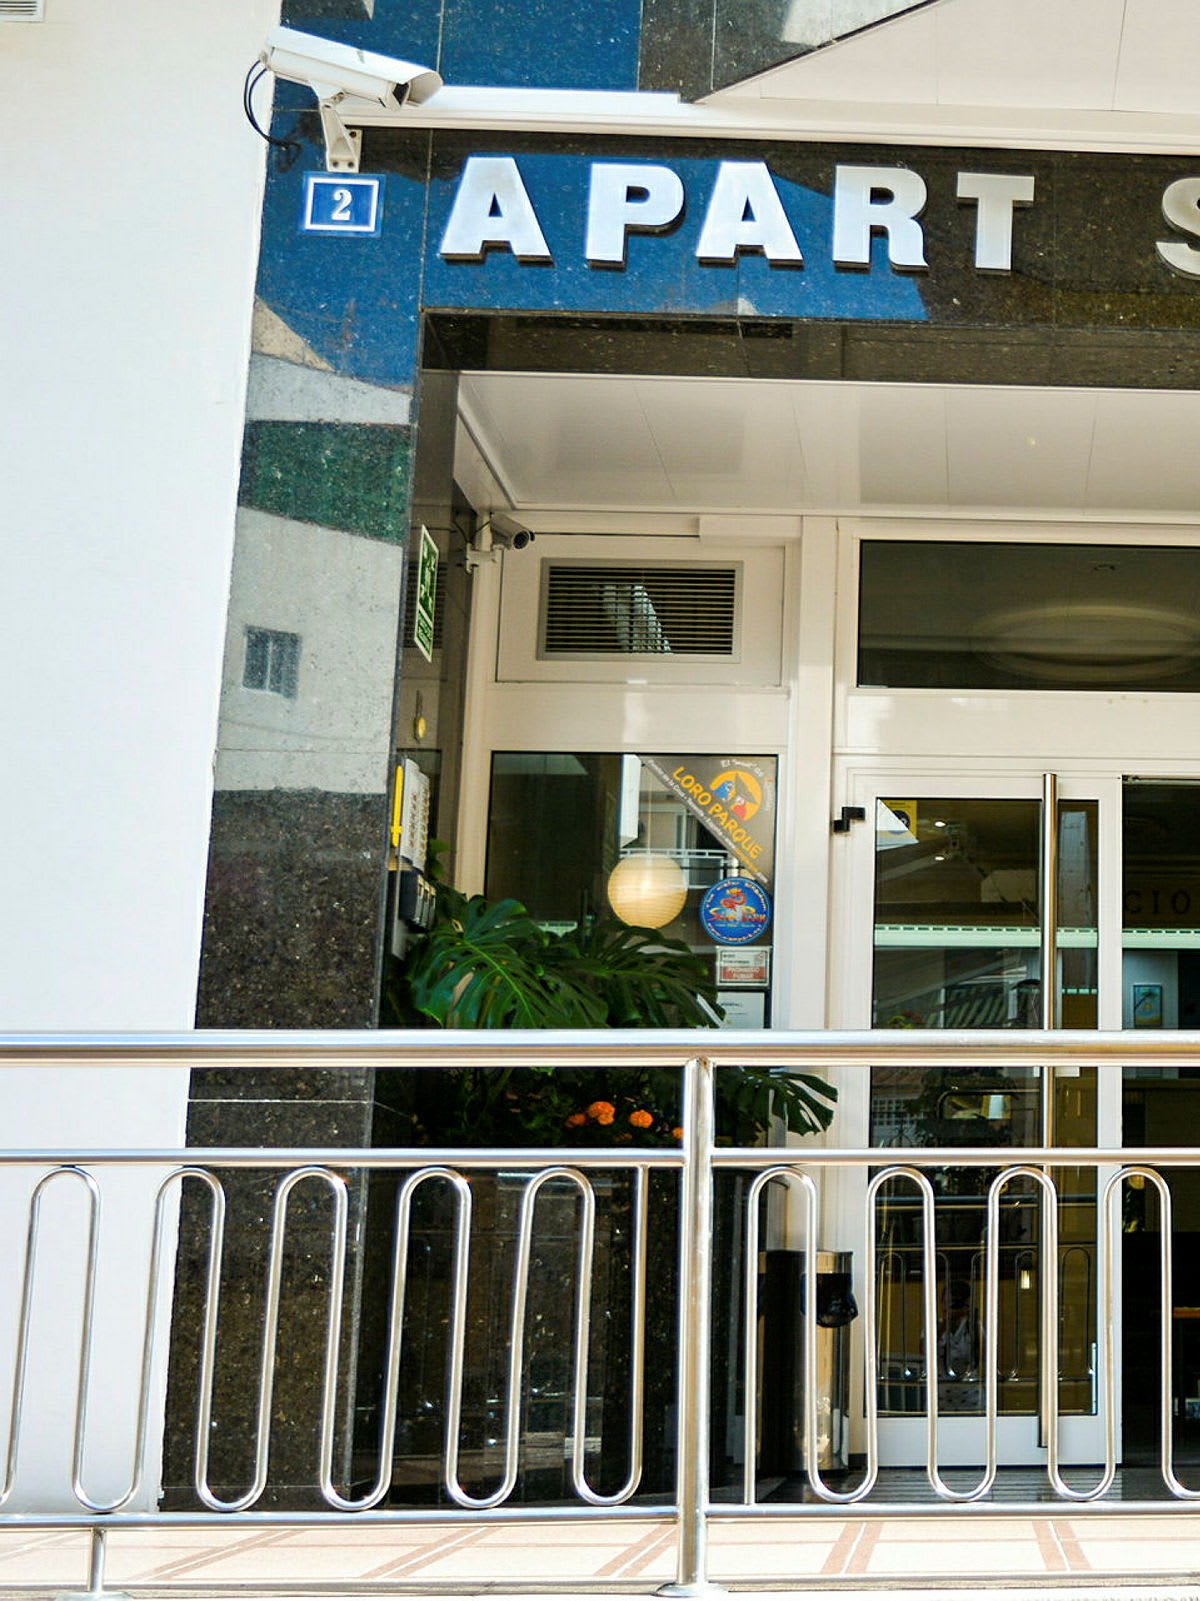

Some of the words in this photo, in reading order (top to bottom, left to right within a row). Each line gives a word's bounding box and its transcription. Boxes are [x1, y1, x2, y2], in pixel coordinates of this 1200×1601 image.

[332, 189, 352, 220] 2
[440, 155, 1036, 274] APART
[672, 766, 712, 805] LORO
[708, 802, 762, 859] PARQUE
